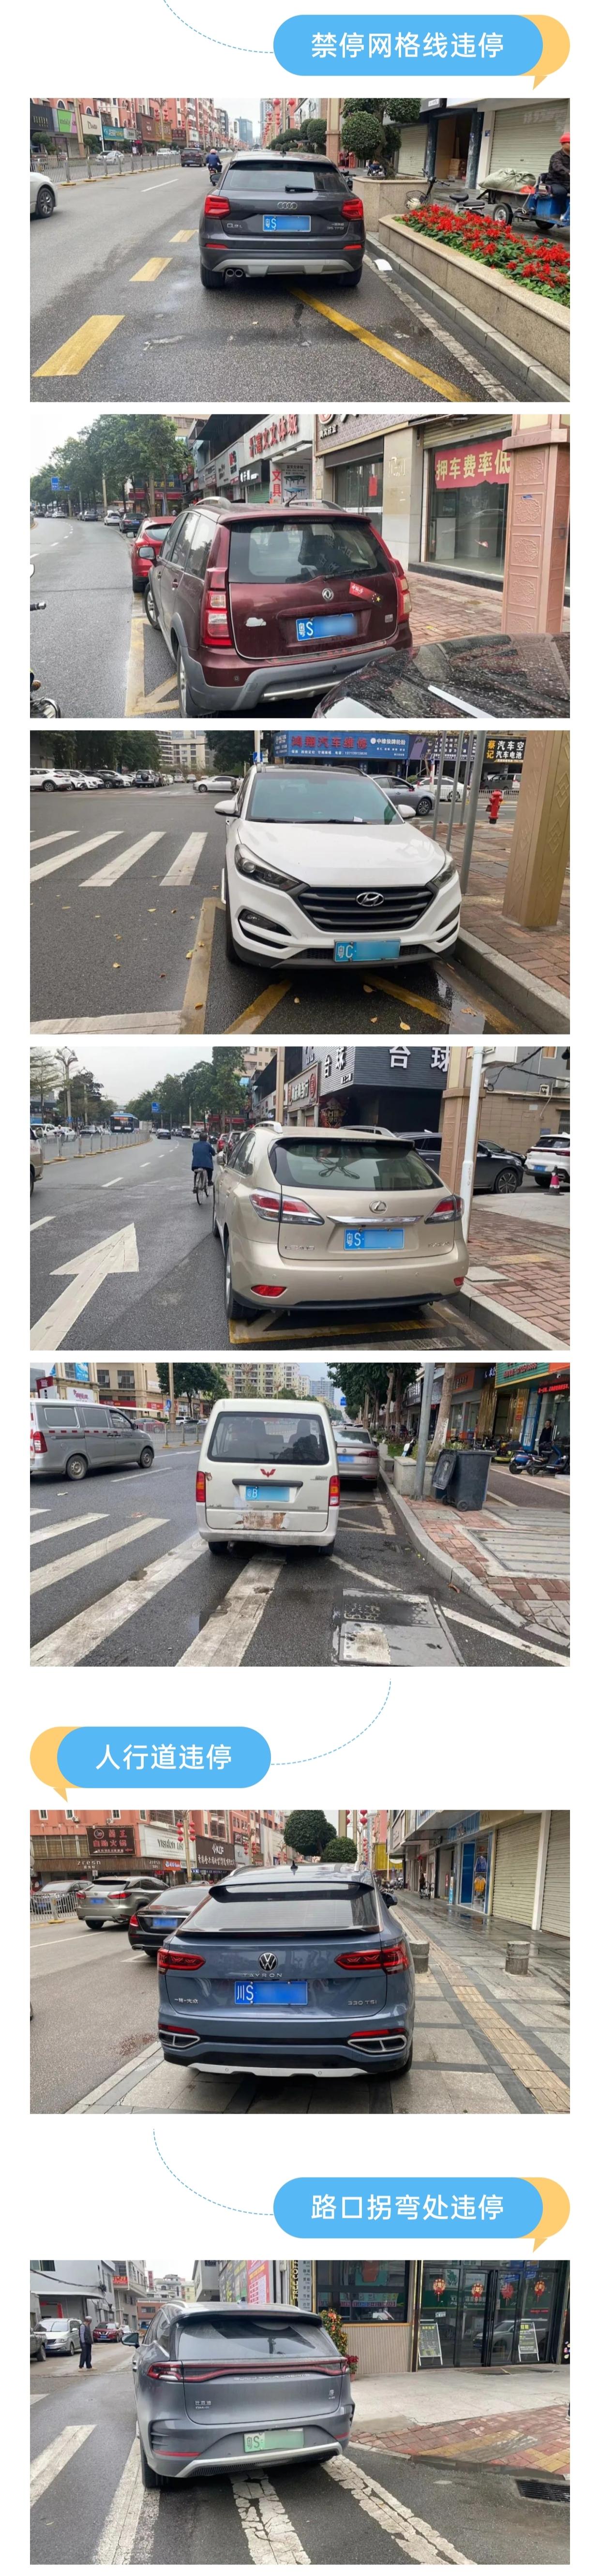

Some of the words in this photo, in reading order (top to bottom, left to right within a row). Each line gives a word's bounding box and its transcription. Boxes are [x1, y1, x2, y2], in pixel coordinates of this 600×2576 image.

[436, 449, 511, 481] 押车费率低
[272, 470, 281, 497] 文具
[291, 735, 367, 749] 鸿翔汽车维修
[486, 740, 496, 759] 蔡记
[497, 740, 525, 751] 汽车空
[496, 751, 523, 759] 汽车电池
[389, 1046, 449, 1072] 台球
[237, 1984, 254, 2001] 川S
